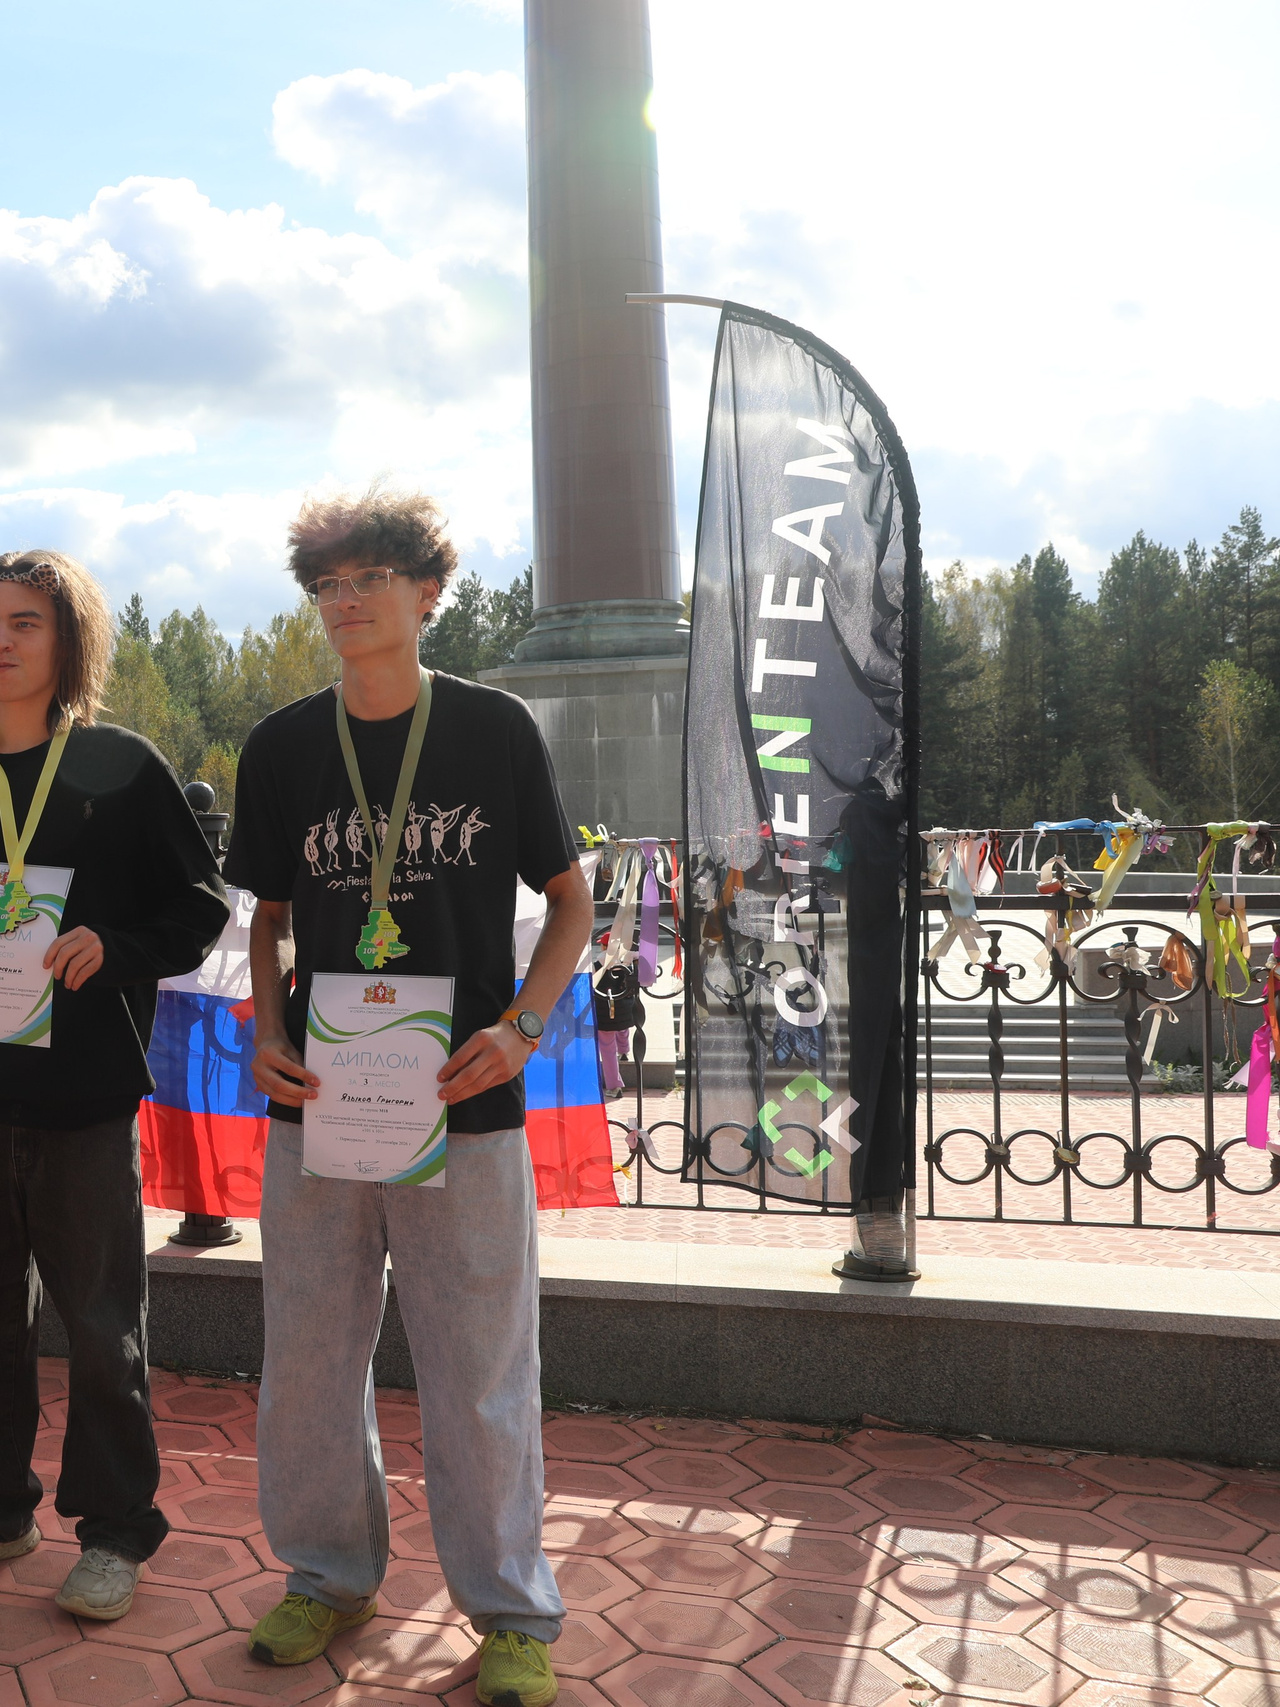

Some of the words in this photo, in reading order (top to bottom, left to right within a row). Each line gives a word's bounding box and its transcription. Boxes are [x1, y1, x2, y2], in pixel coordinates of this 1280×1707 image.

[751, 416, 855, 1028] ORIENTEAM
[406, 870, 434, 882] Selva.
[331, 1051, 419, 1070] ДИПЛОМ
[363, 1078, 369, 1086] 3
[374, 1081, 401, 1089] МЕСТО
[340, 1092, 372, 1104] Языков
[376, 1095, 415, 1106] Григорий
